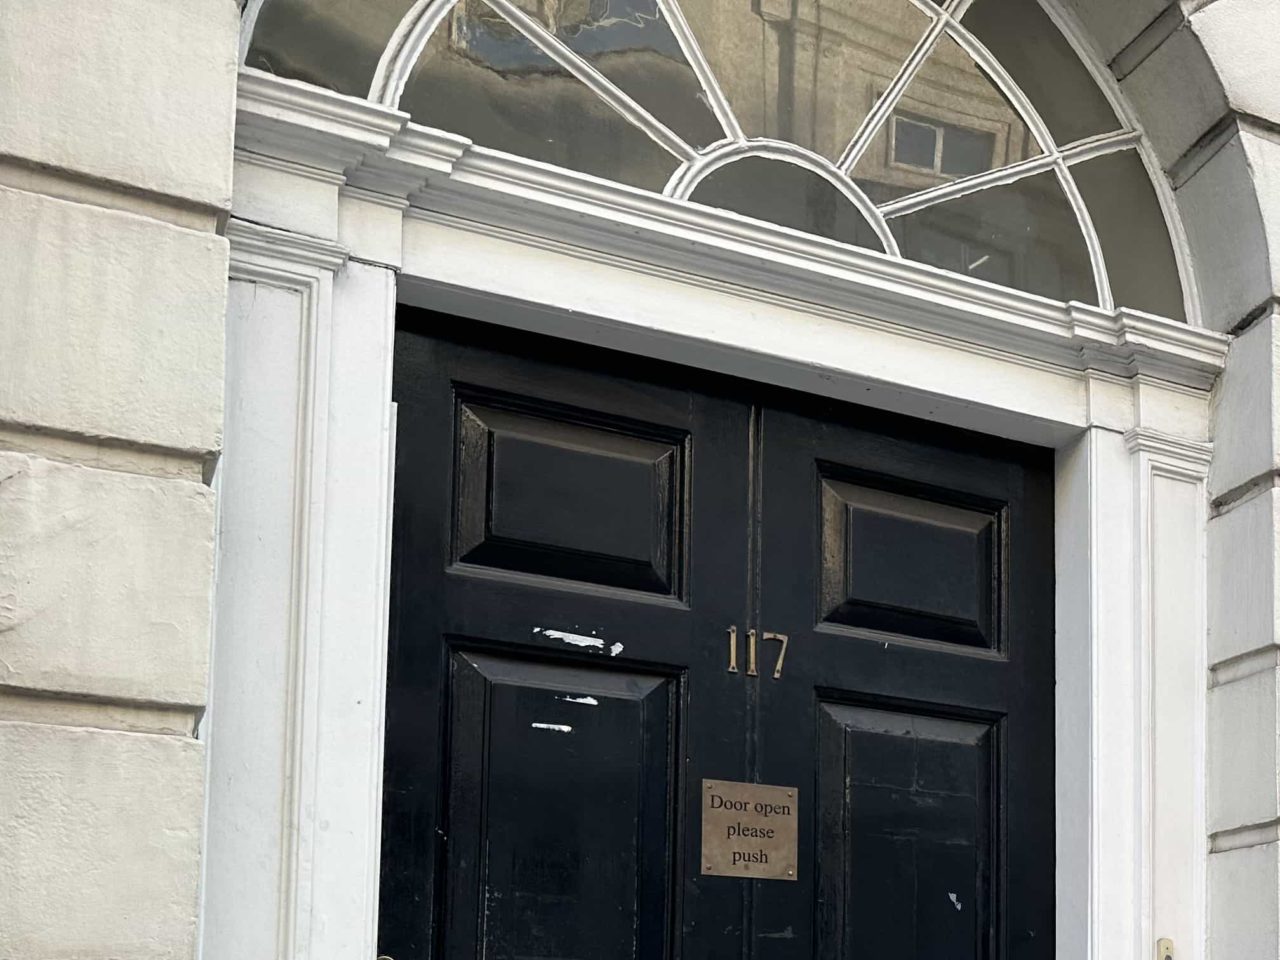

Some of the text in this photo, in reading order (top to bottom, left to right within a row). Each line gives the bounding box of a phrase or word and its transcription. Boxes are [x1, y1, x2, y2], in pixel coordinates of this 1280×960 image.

[726, 624, 788, 679] 117
[710, 794, 790, 816] Door open
[727, 822, 774, 839] please
[732, 850, 768, 865] push
